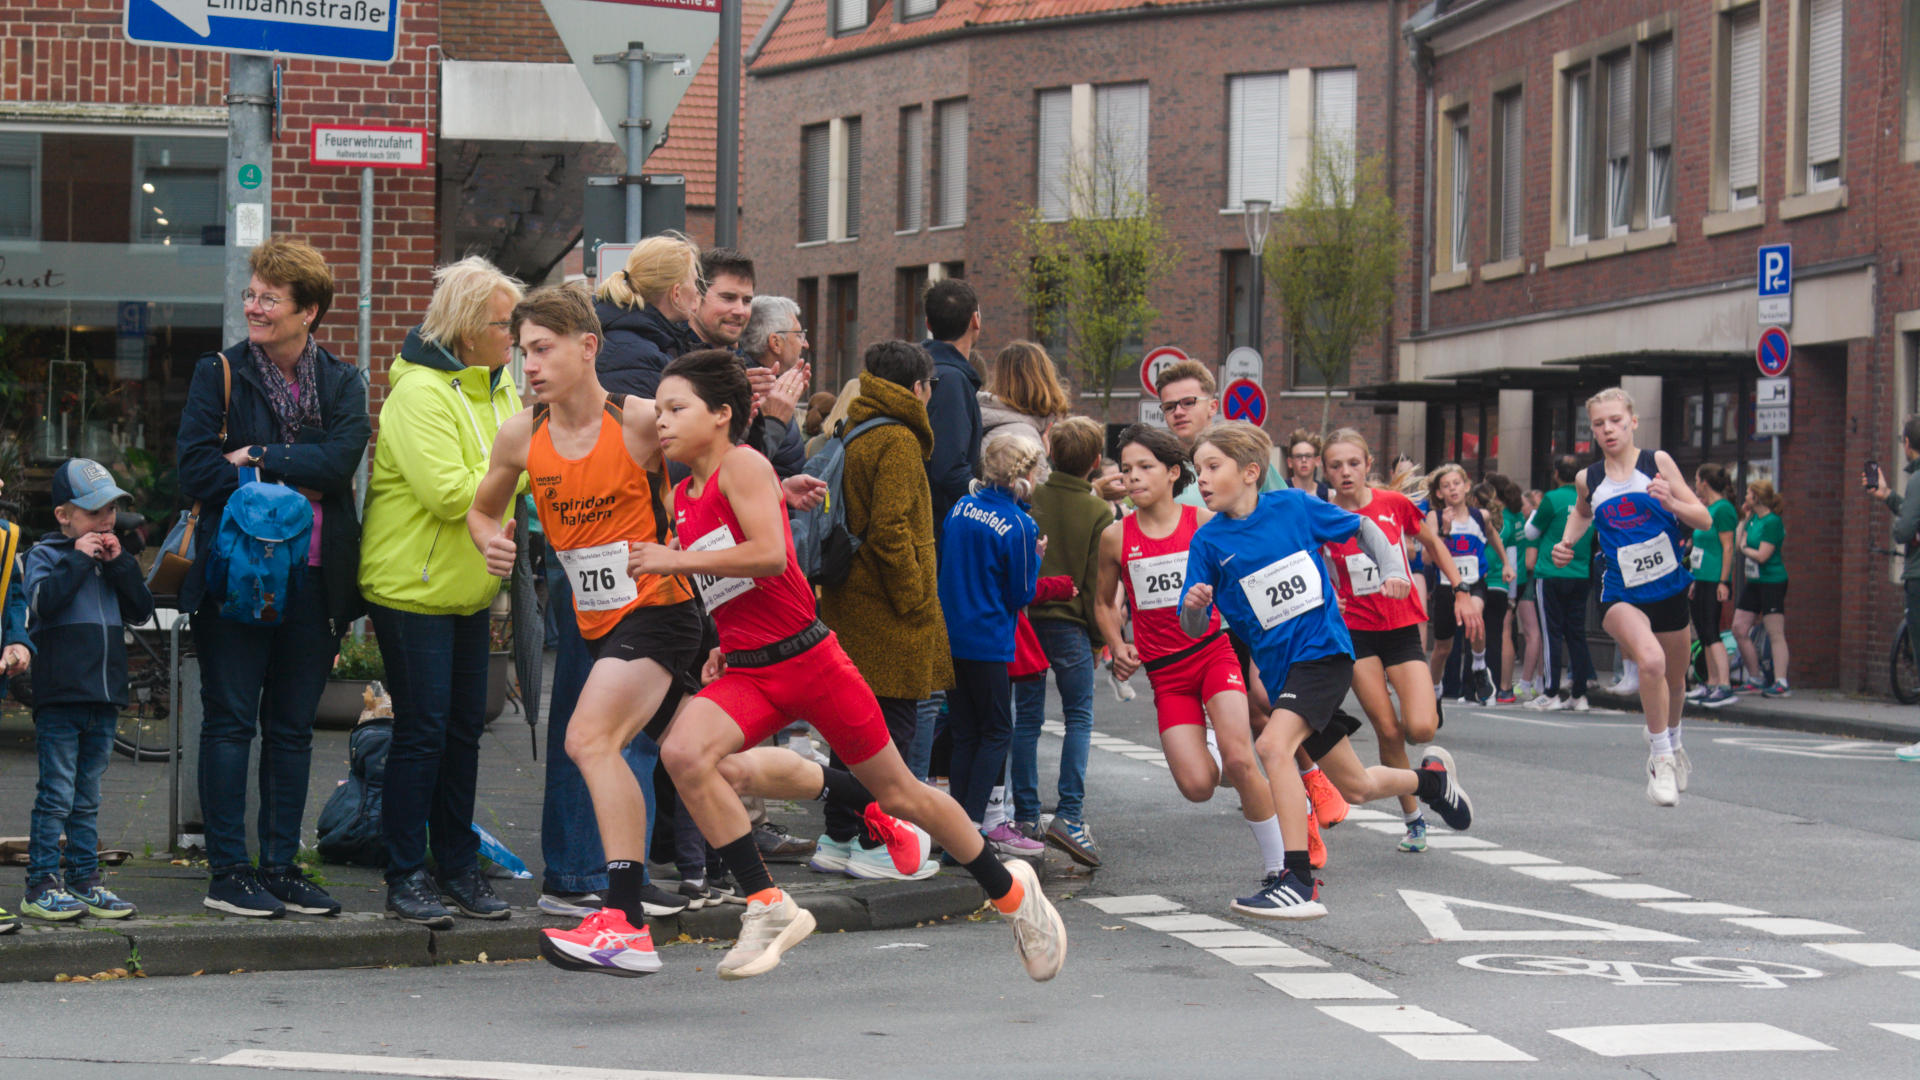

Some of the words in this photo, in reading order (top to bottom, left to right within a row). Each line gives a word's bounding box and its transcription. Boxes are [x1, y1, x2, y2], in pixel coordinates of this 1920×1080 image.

[325, 133, 413, 149] Feuerwehrzufahrt
[246, 168, 254, 179] 4
[1765, 252, 1784, 291] P
[1145, 410, 1164, 423] Tiefg
[552, 495, 616, 517] spiridon
[561, 509, 613, 526] haltern
[963, 502, 1013, 537] Coesfeld
[1633, 551, 1664, 573] 256
[579, 567, 616, 592] 276
[1146, 571, 1183, 593] 263
[1265, 574, 1307, 608] 289
[779, 617, 827, 655] erima
[607, 861, 631, 871] ep
